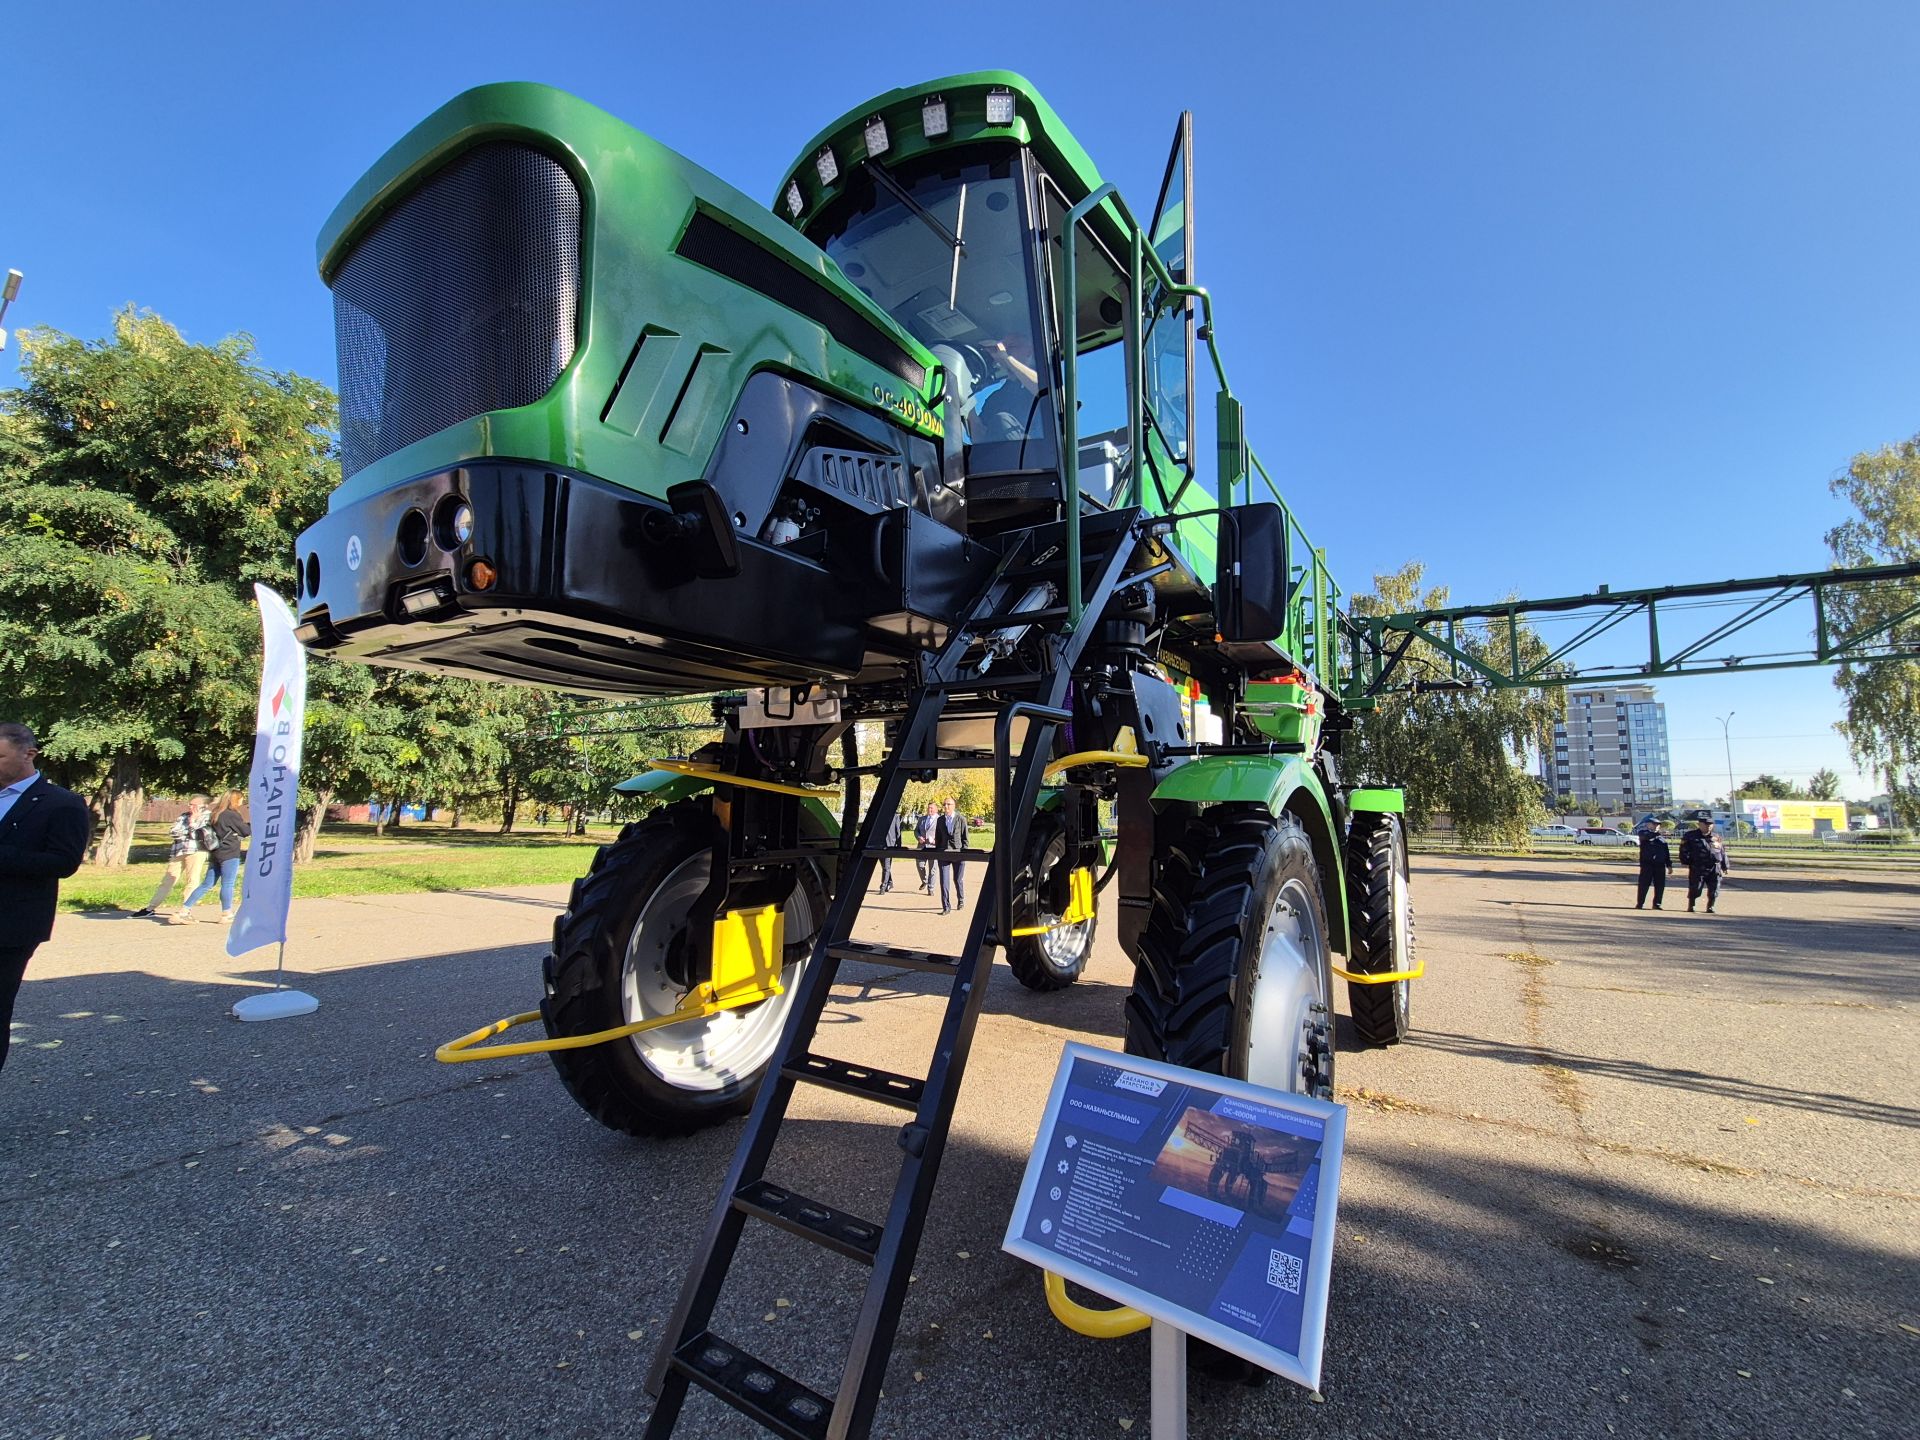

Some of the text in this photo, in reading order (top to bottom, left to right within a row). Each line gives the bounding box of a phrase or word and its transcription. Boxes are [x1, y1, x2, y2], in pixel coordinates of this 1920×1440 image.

[1119, 1079, 1153, 1092] ТАТАРСТАНЕ
[1122, 1074, 1149, 1085] СДЕЛАНО
[1069, 1099, 1140, 1125] ООО «КАЗАНЬСЕЛЬМАШ»
[1223, 1106, 1257, 1122] ОС-4000М
[1224, 1098, 1323, 1129] Самоходный опрыскиватель
